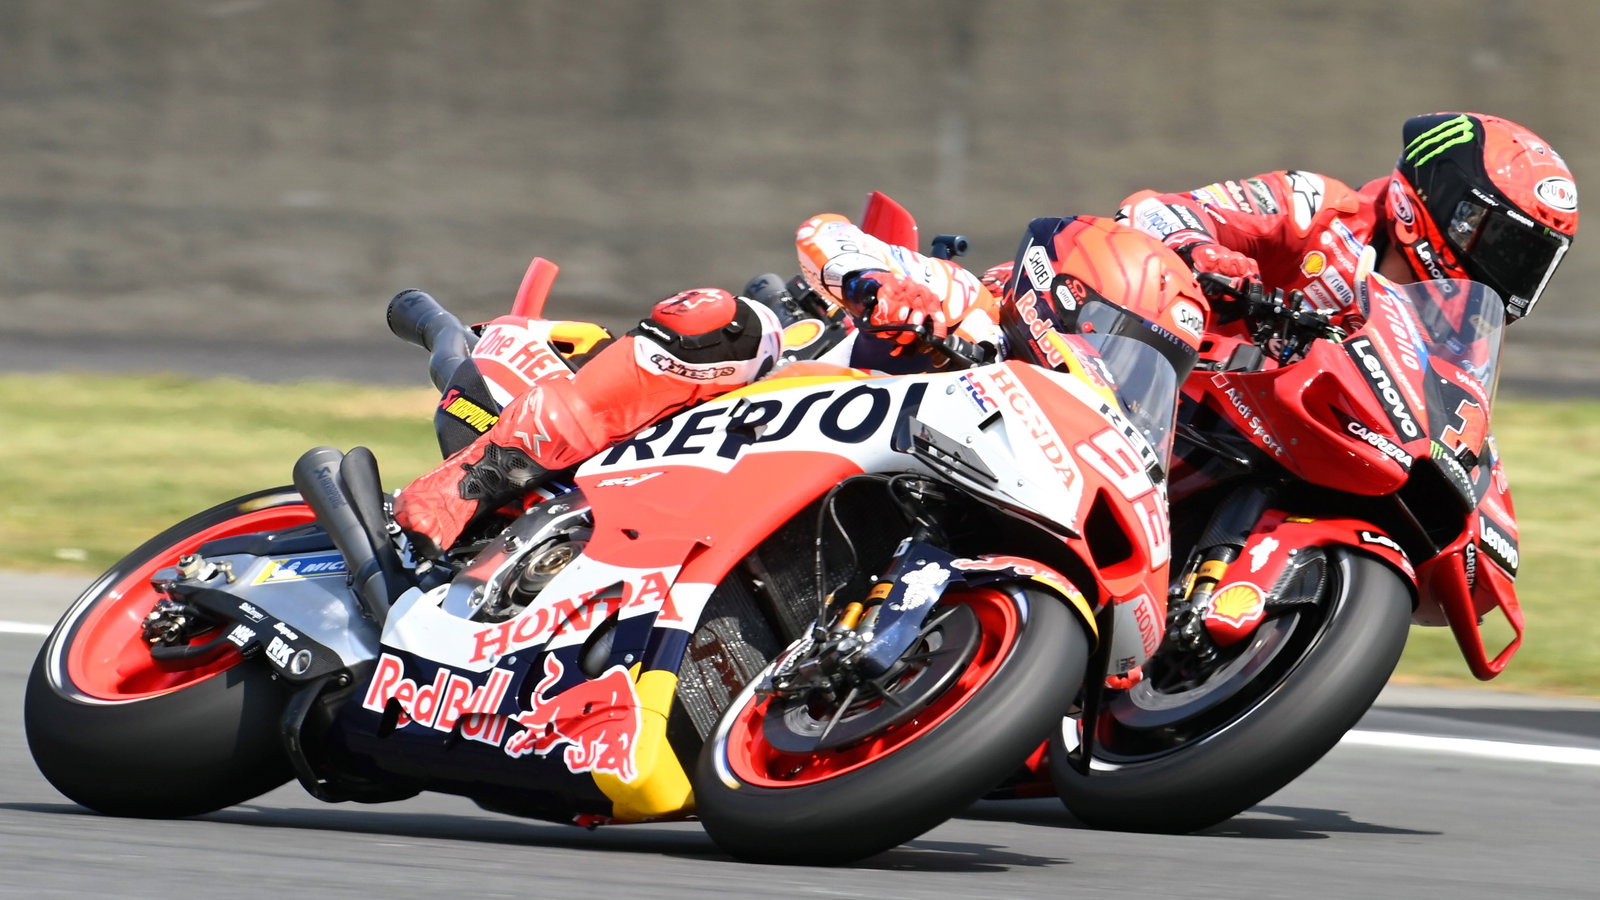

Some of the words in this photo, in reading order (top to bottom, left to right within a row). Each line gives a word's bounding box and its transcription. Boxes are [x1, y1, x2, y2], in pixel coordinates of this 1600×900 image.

[1029, 251, 1050, 285] SHOEI
[1331, 278, 1352, 304] riello
[1416, 241, 1453, 293] Lenovo
[1059, 287, 1073, 306] SHOEI
[475, 327, 515, 357] One
[1015, 289, 1053, 340] Red
[1037, 328, 1065, 368] Bu
[1150, 323, 1179, 345] GIVES
[1352, 339, 1418, 438] Lenovo
[600, 382, 929, 467] REPSOL
[1225, 387, 1252, 418] Audi
[1248, 416, 1284, 457] Sport
[1347, 421, 1413, 468] CARRERA
[1480, 516, 1519, 569] Lenovo
[468, 570, 684, 664] HONDA
[267, 635, 296, 664] RK
[363, 652, 451, 729] Red
[437, 666, 515, 748] Bull
